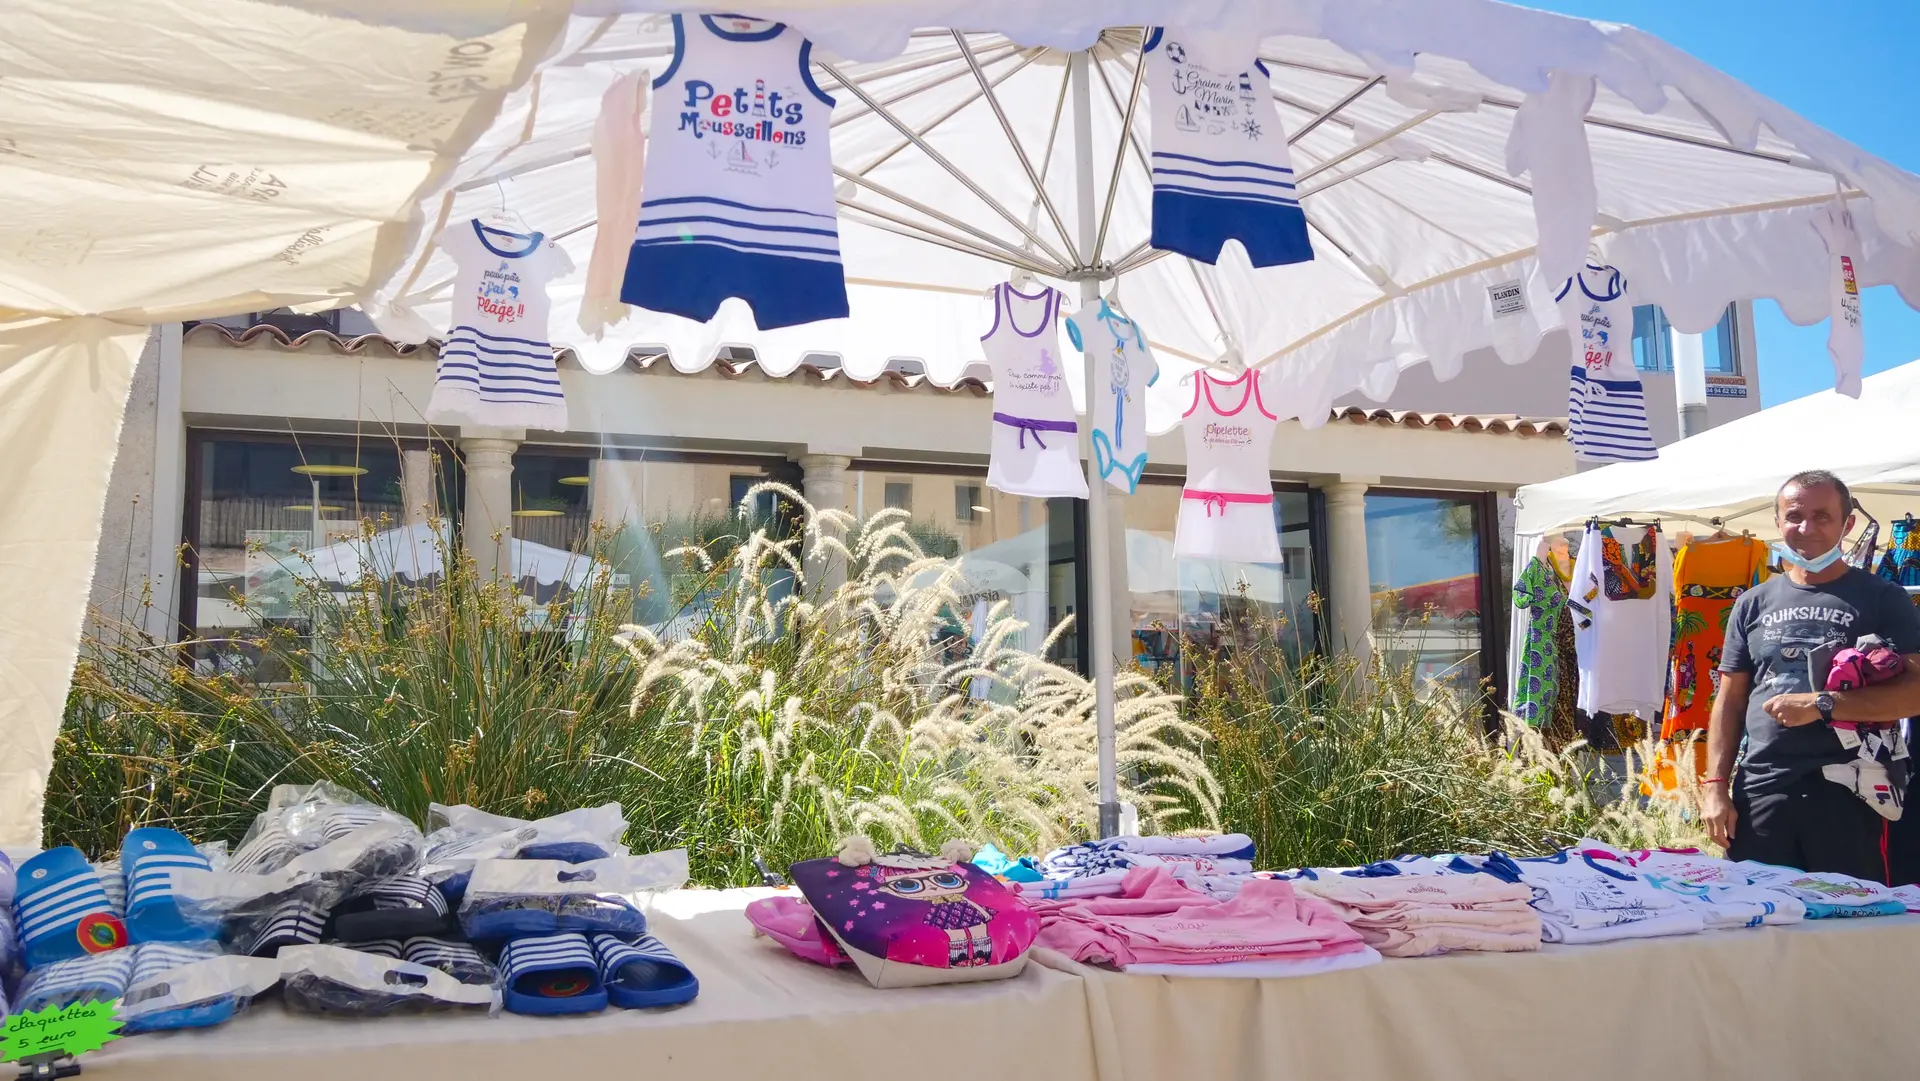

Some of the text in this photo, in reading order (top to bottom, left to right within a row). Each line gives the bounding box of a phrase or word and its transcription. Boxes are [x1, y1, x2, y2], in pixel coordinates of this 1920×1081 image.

[1187, 71, 1236, 92] Graine de
[684, 79, 804, 125] Petits
[1194, 87, 1234, 104] Marin
[678, 112, 806, 145] Moussaillons
[484, 281, 505, 297] j'ai
[1493, 287, 1520, 301] FLANDIN
[517, 303, 525, 318] !!
[1593, 316, 1612, 328] pas
[1206, 423, 1248, 438] Pipelette
[1762, 606, 1854, 627] QUIKSILVER
[1827, 626, 1846, 637] Since
[18, 1030, 76, 1049] 5 euro
